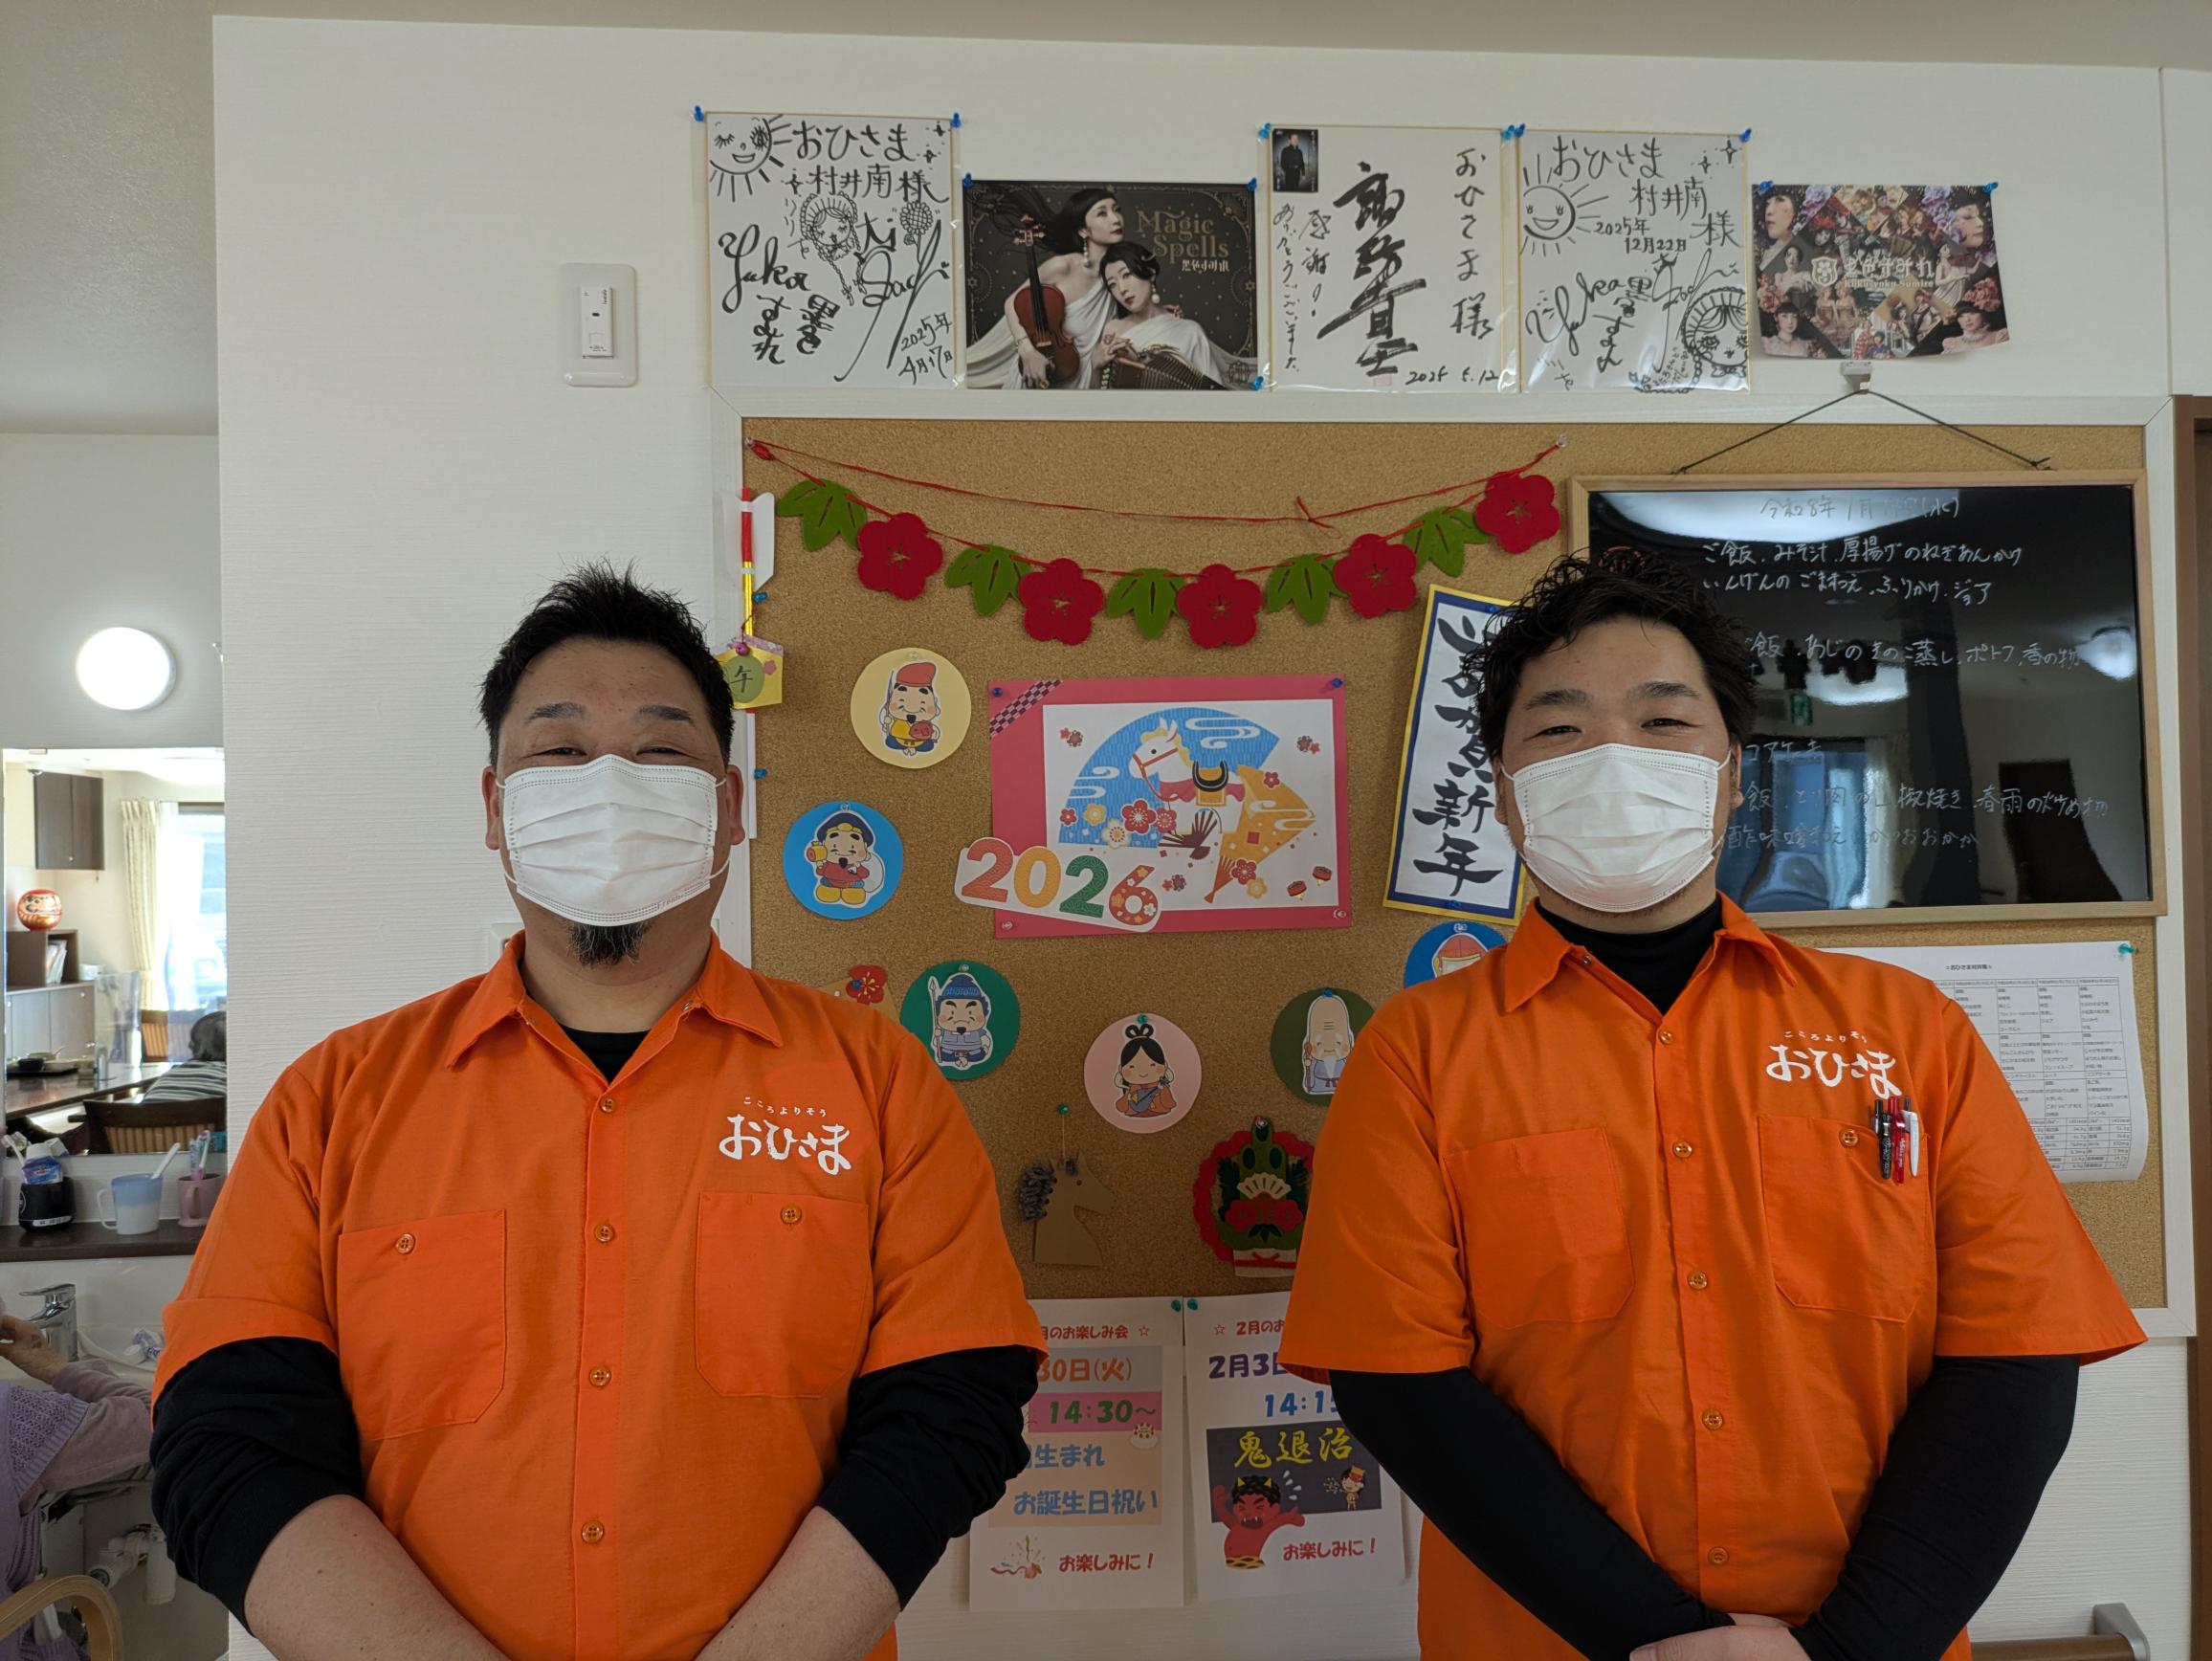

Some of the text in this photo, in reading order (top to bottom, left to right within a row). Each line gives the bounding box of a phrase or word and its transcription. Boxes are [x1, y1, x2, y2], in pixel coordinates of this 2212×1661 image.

[792, 121, 916, 161] おひさま
[1553, 135, 1664, 182] おひさま
[1136, 210, 1214, 241] Magic
[1594, 217, 1650, 236] 2025年
[1141, 234, 1229, 263] Spells
[1625, 238, 1687, 254] 12月22日
[729, 665, 753, 693] 午
[962, 838, 1159, 926] 2026
[1765, 1044, 1903, 1099] おひさま
[743, 1096, 827, 1118] こころよりそう
[719, 1113, 852, 1176] おひさま
[1025, 1443, 1105, 1469] 生まれ
[1234, 1427, 1353, 1469] 鬼退治
[1013, 1488, 1159, 1517] お誕生日祝い
